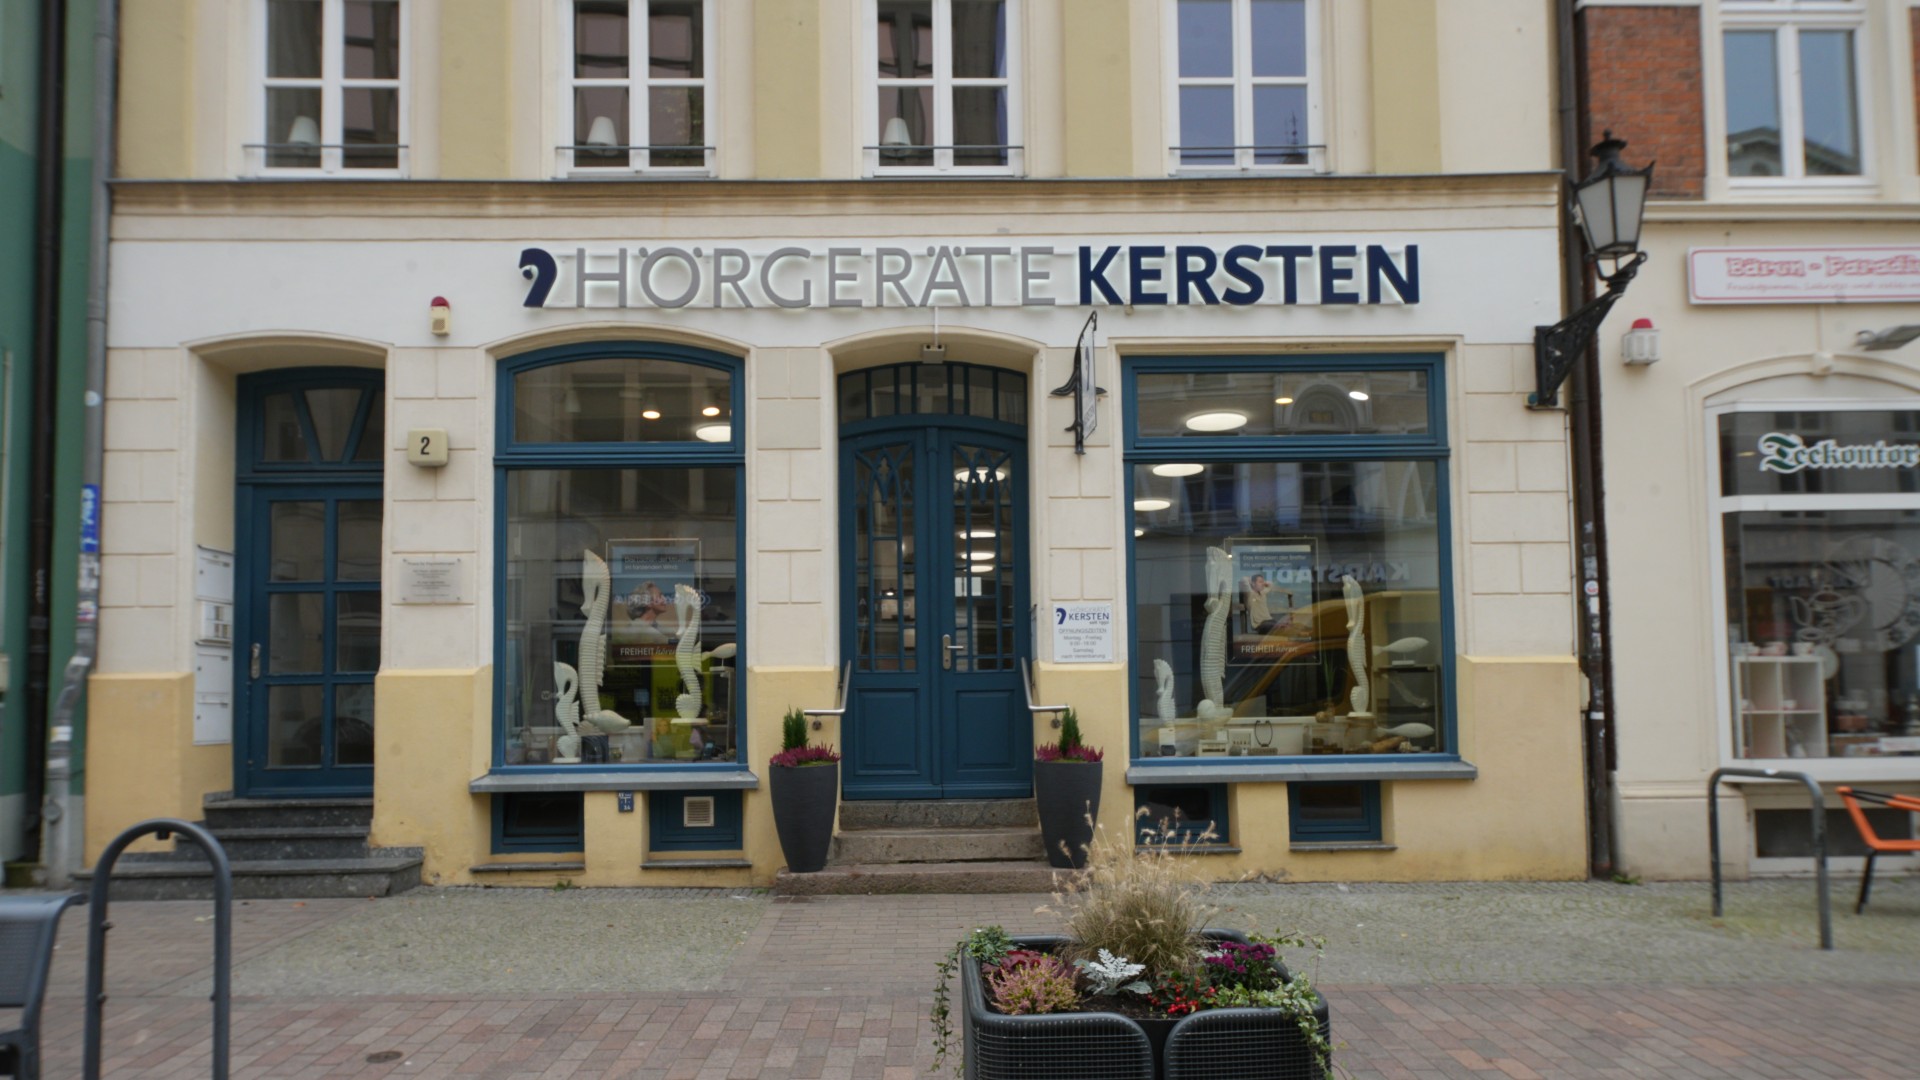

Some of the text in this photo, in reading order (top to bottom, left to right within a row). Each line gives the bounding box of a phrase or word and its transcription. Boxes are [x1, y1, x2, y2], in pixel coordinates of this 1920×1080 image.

[576, 244, 1420, 308] HÖRGERÄTE KERSTEN
[420, 436, 431, 455] 2
[1068, 612, 1110, 620] KERSTEN
[620, 647, 654, 656] FREIHEIT
[1241, 645, 1274, 653] FREIHEIT
